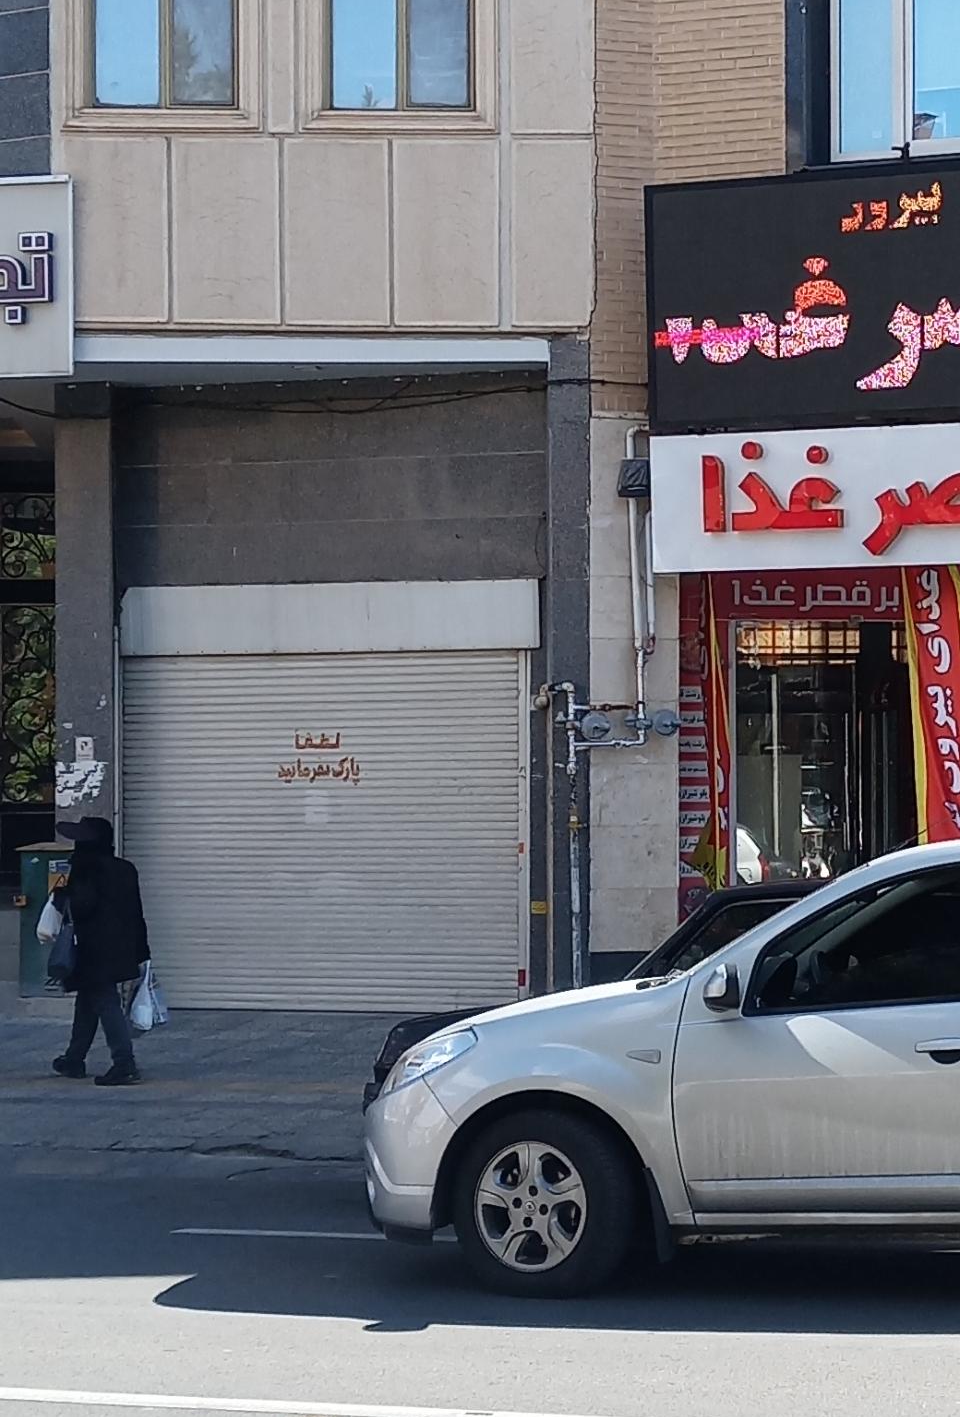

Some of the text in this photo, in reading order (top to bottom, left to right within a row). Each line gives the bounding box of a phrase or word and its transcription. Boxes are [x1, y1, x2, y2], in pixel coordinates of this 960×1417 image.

[701, 441, 846, 534] غذا
[731, 579, 796, 606] غذا
[799, 580, 871, 612] قصر
[916, 568, 951, 673] غذای
[332, 757, 361, 786] پارک
